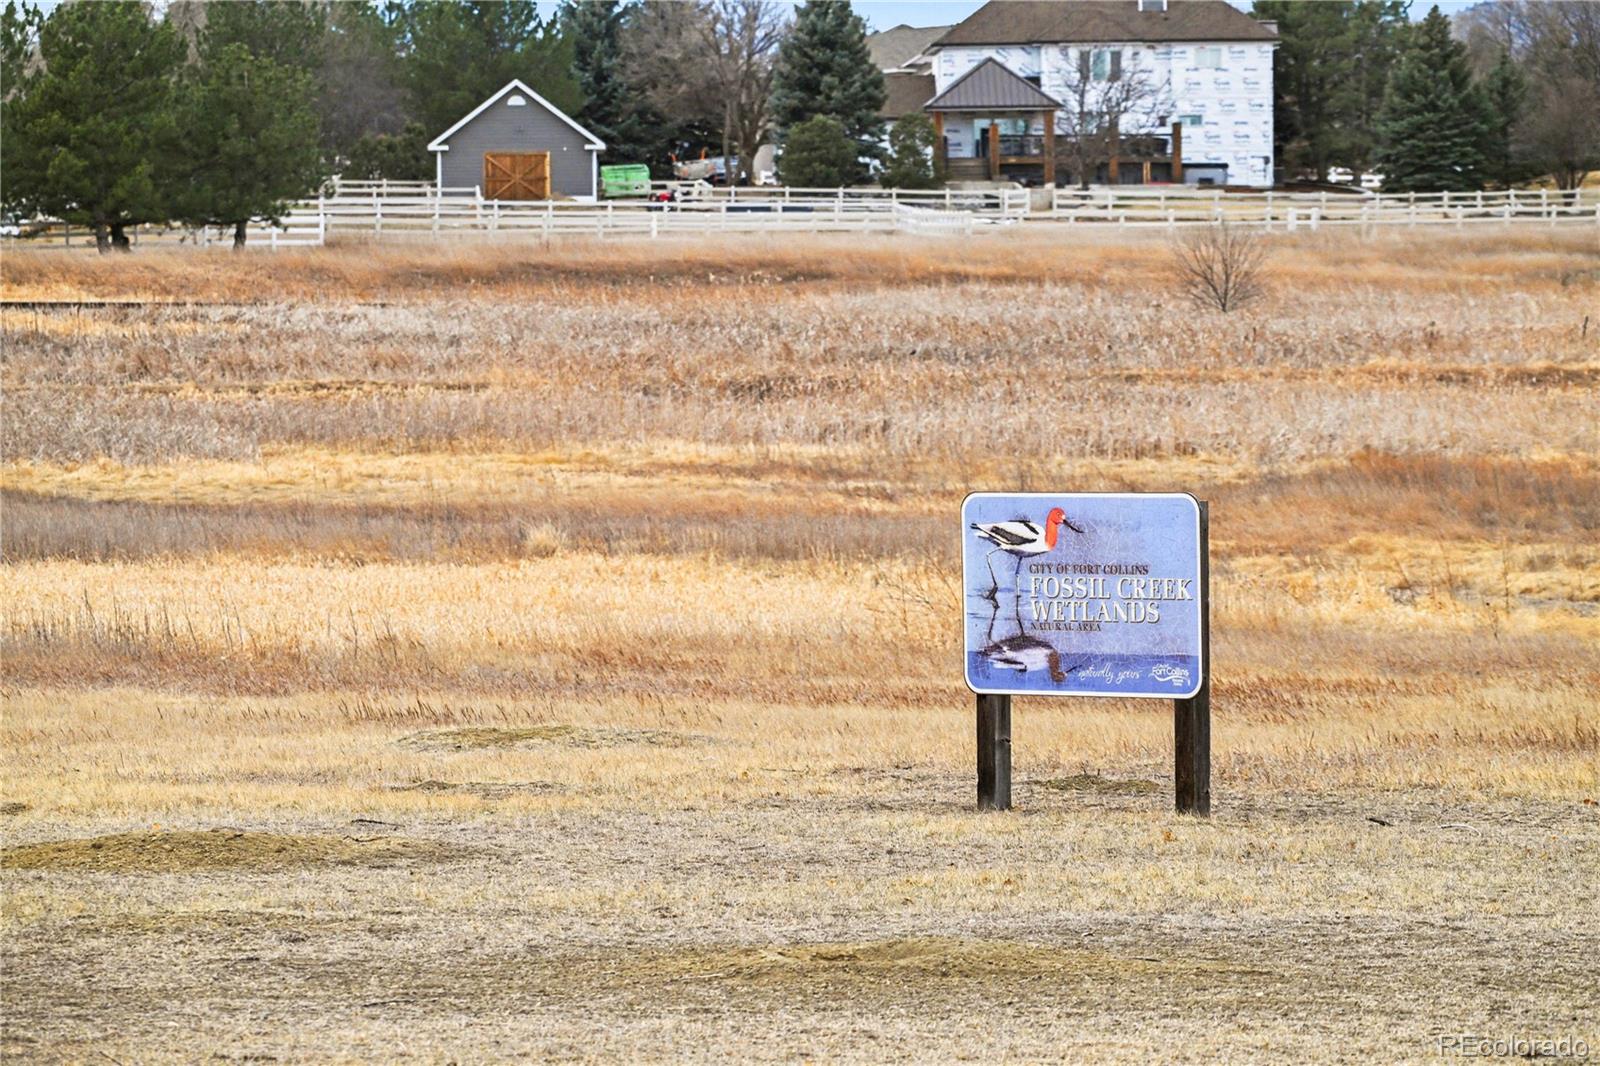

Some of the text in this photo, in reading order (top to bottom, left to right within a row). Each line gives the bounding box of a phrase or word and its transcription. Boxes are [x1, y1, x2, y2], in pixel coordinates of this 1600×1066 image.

[1029, 564, 1149, 576] CITY OF FORT COLLINS
[1030, 576, 1193, 601] FOSSIL CREEK
[1030, 600, 1161, 624] WETLANDS
[1030, 622, 1102, 632] NATURAL AREA
